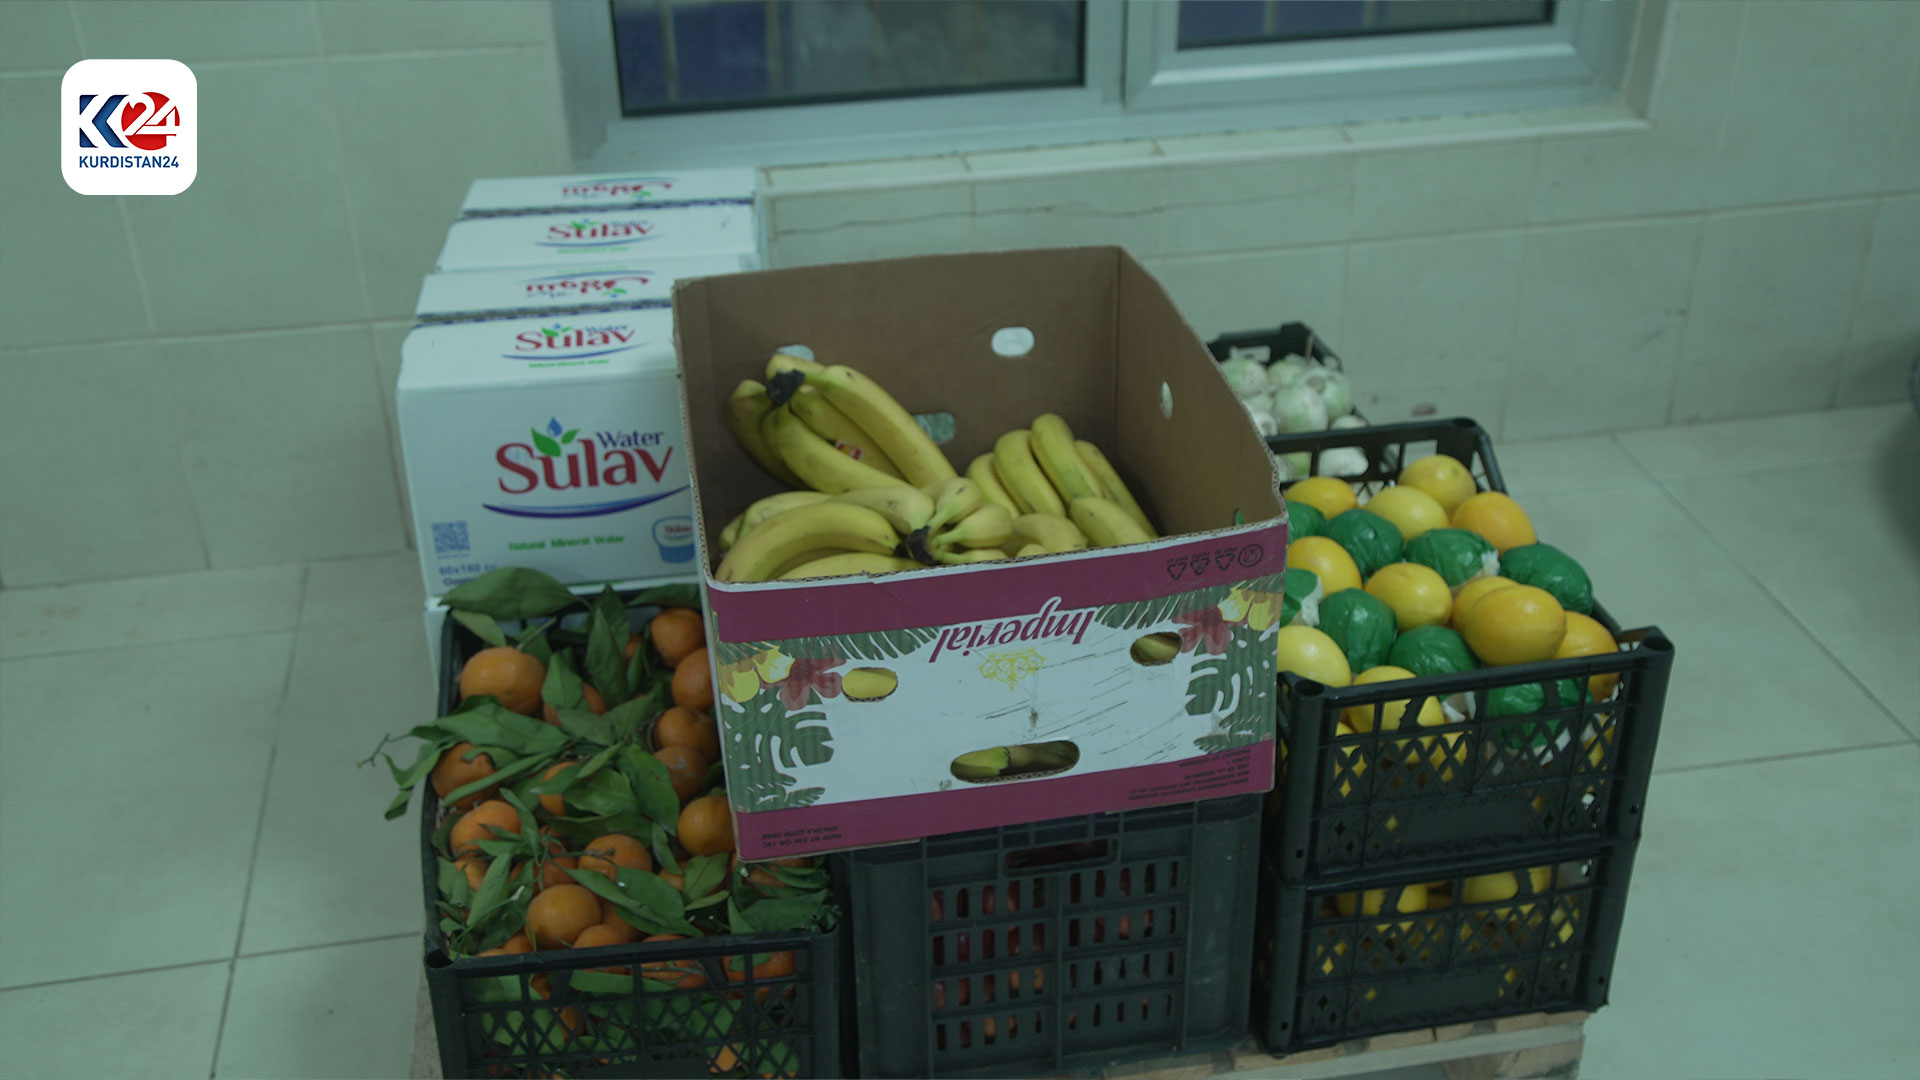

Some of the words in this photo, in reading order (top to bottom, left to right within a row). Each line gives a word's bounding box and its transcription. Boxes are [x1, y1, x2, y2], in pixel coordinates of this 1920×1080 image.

[548, 223, 655, 240] Sulav
[515, 329, 636, 351] Sulav
[596, 429, 664, 448] Water
[495, 438, 674, 495] Sulav
[507, 540, 546, 551] Natural
[550, 536, 591, 548] Mineral
[593, 534, 626, 545] Water
[928, 598, 1096, 664] Imperial
